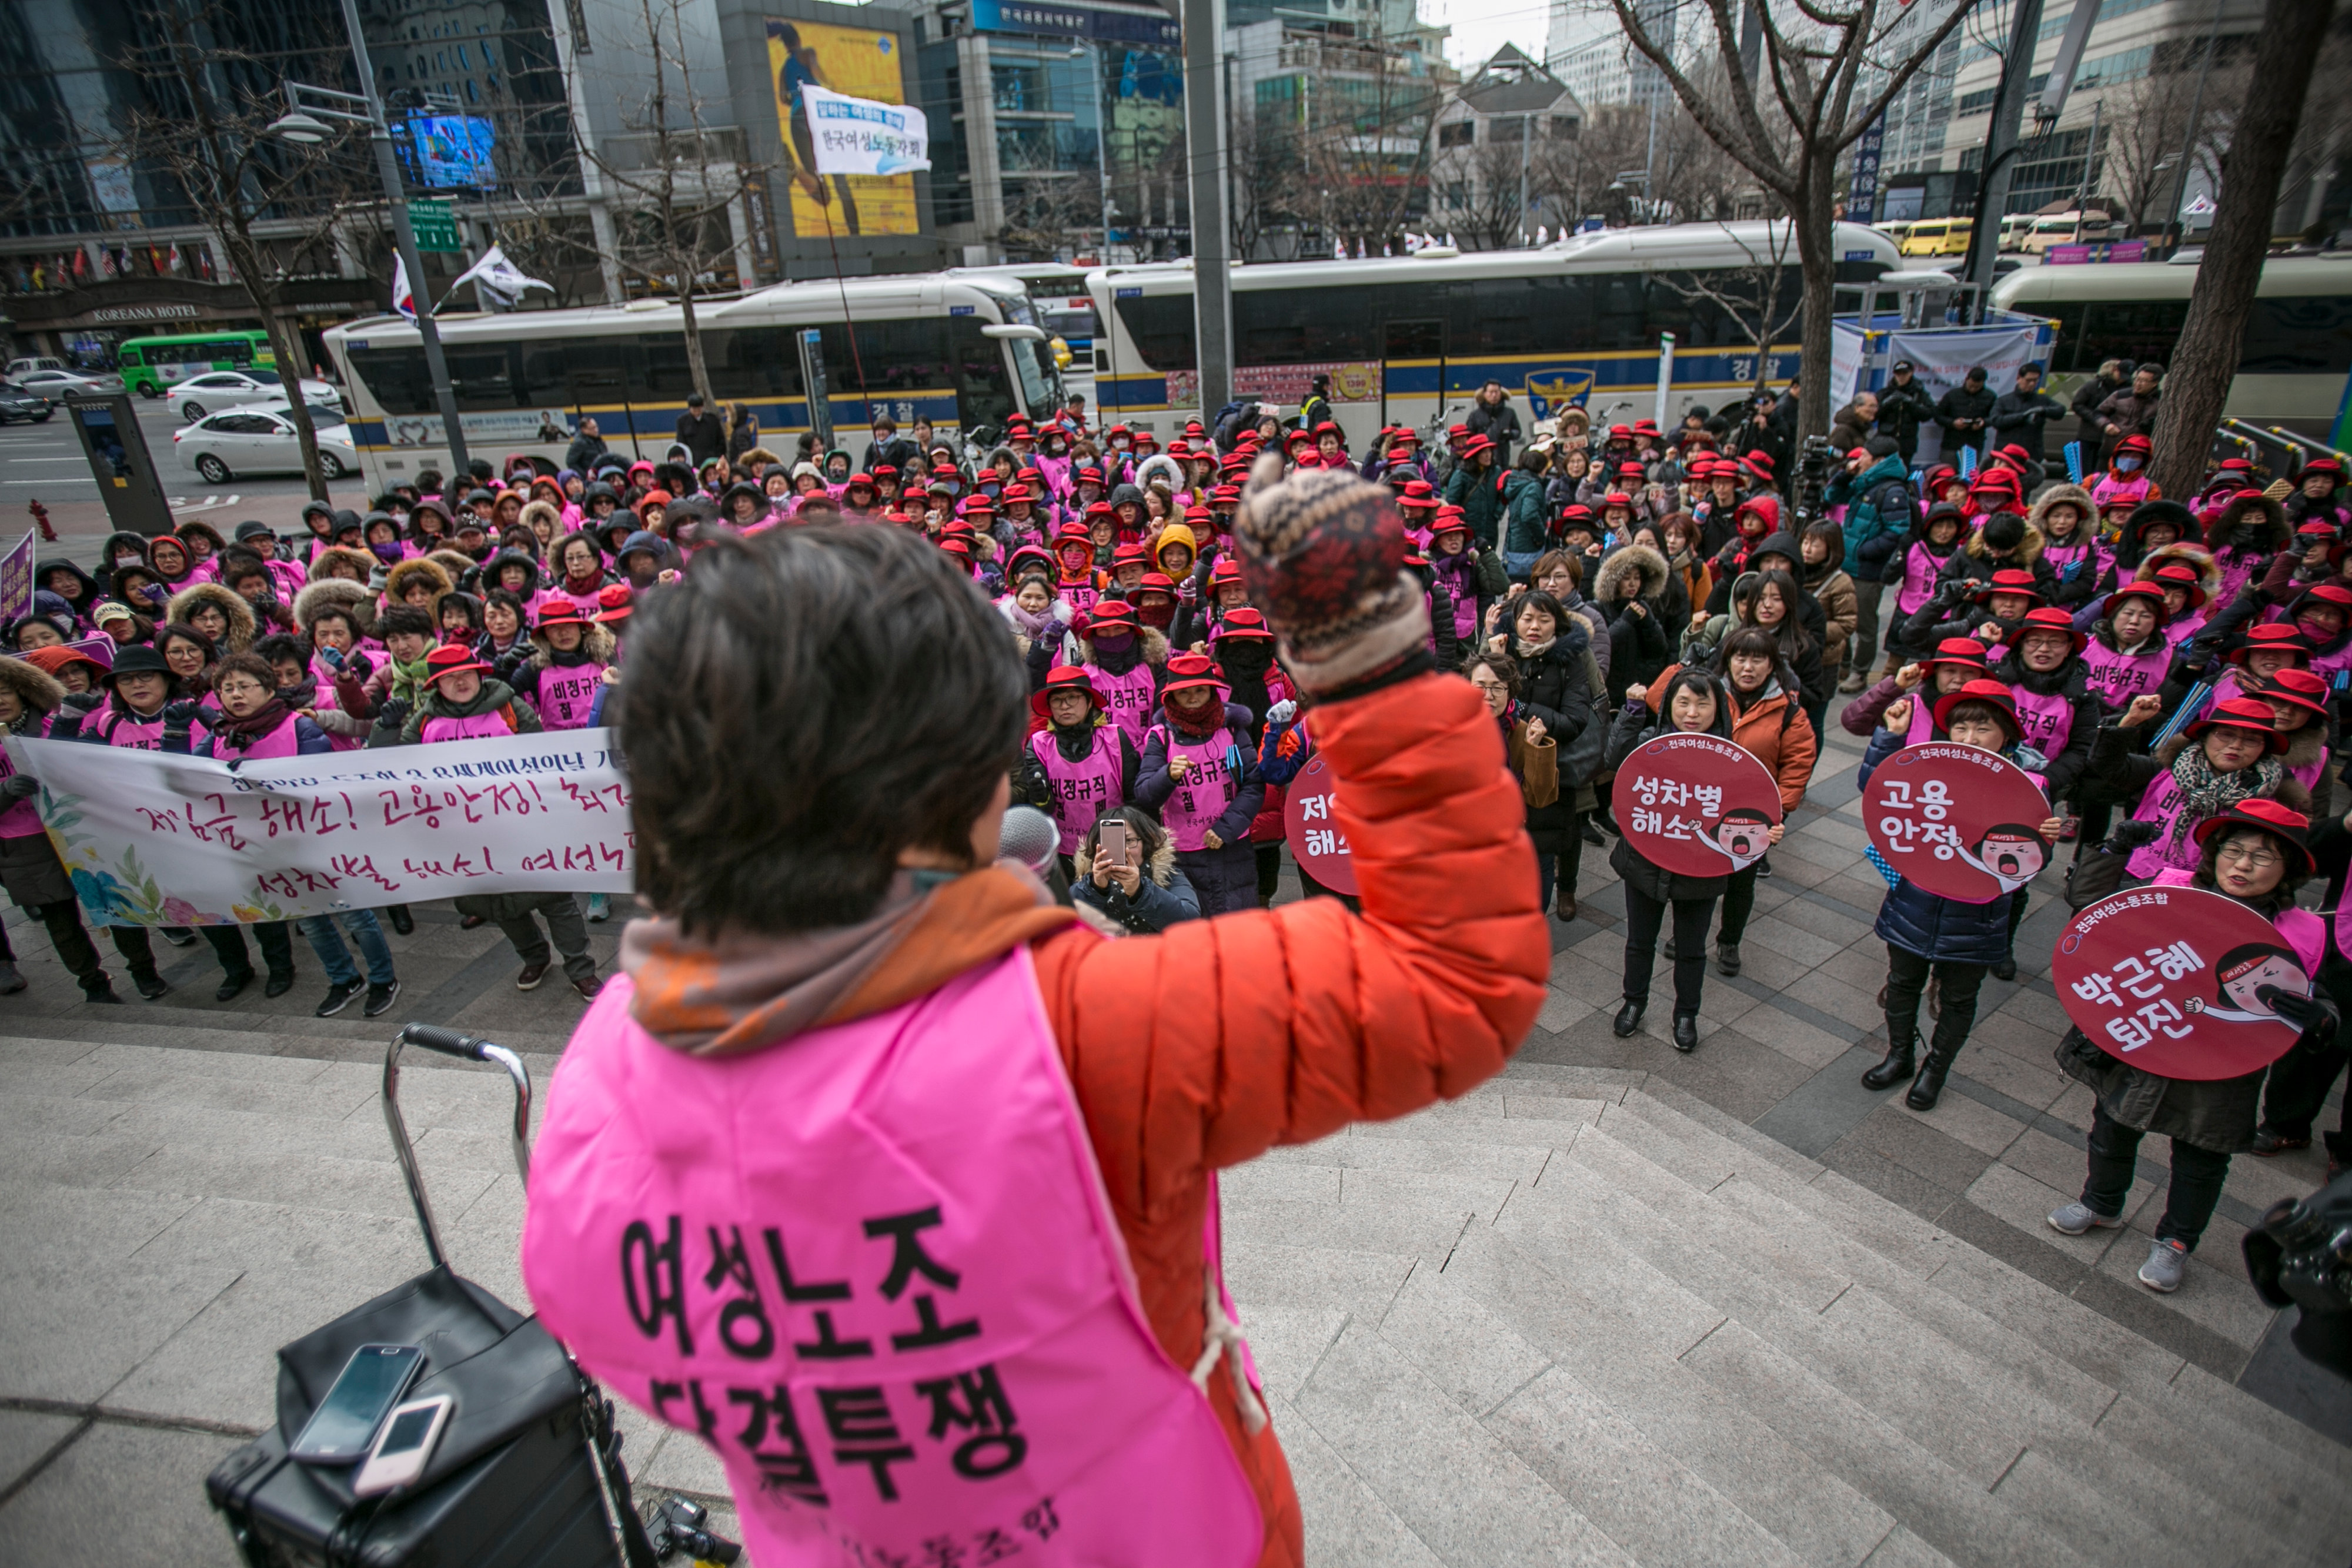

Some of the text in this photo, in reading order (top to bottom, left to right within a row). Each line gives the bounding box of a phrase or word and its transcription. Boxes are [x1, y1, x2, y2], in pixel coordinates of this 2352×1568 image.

[823, 129, 920, 159] 한국여성노동자회
[93, 304, 201, 322] KOREANA HOTEL
[2093, 665, 2149, 690] 비정규직
[1668, 738, 1743, 763] 전국여성노동조합
[1919, 747, 2004, 773] 전국여성노동조합
[259, 791, 358, 838] 해소!
[377, 778, 549, 829] 고용안정!
[1050, 774, 1107, 801] 비정규직
[1631, 775, 1722, 818] 성차별
[1879, 780, 1955, 821] 고용
[1631, 806, 1692, 840] 해소
[1879, 816, 1957, 861] 안정
[256, 854, 400, 898] 성차별
[2074, 892, 2169, 934] 전국여성노동조합
[2071, 940, 2206, 1007] 박근혜
[2105, 998, 2194, 1052] 퇴진
[621, 1205, 982, 1361] 여성노조
